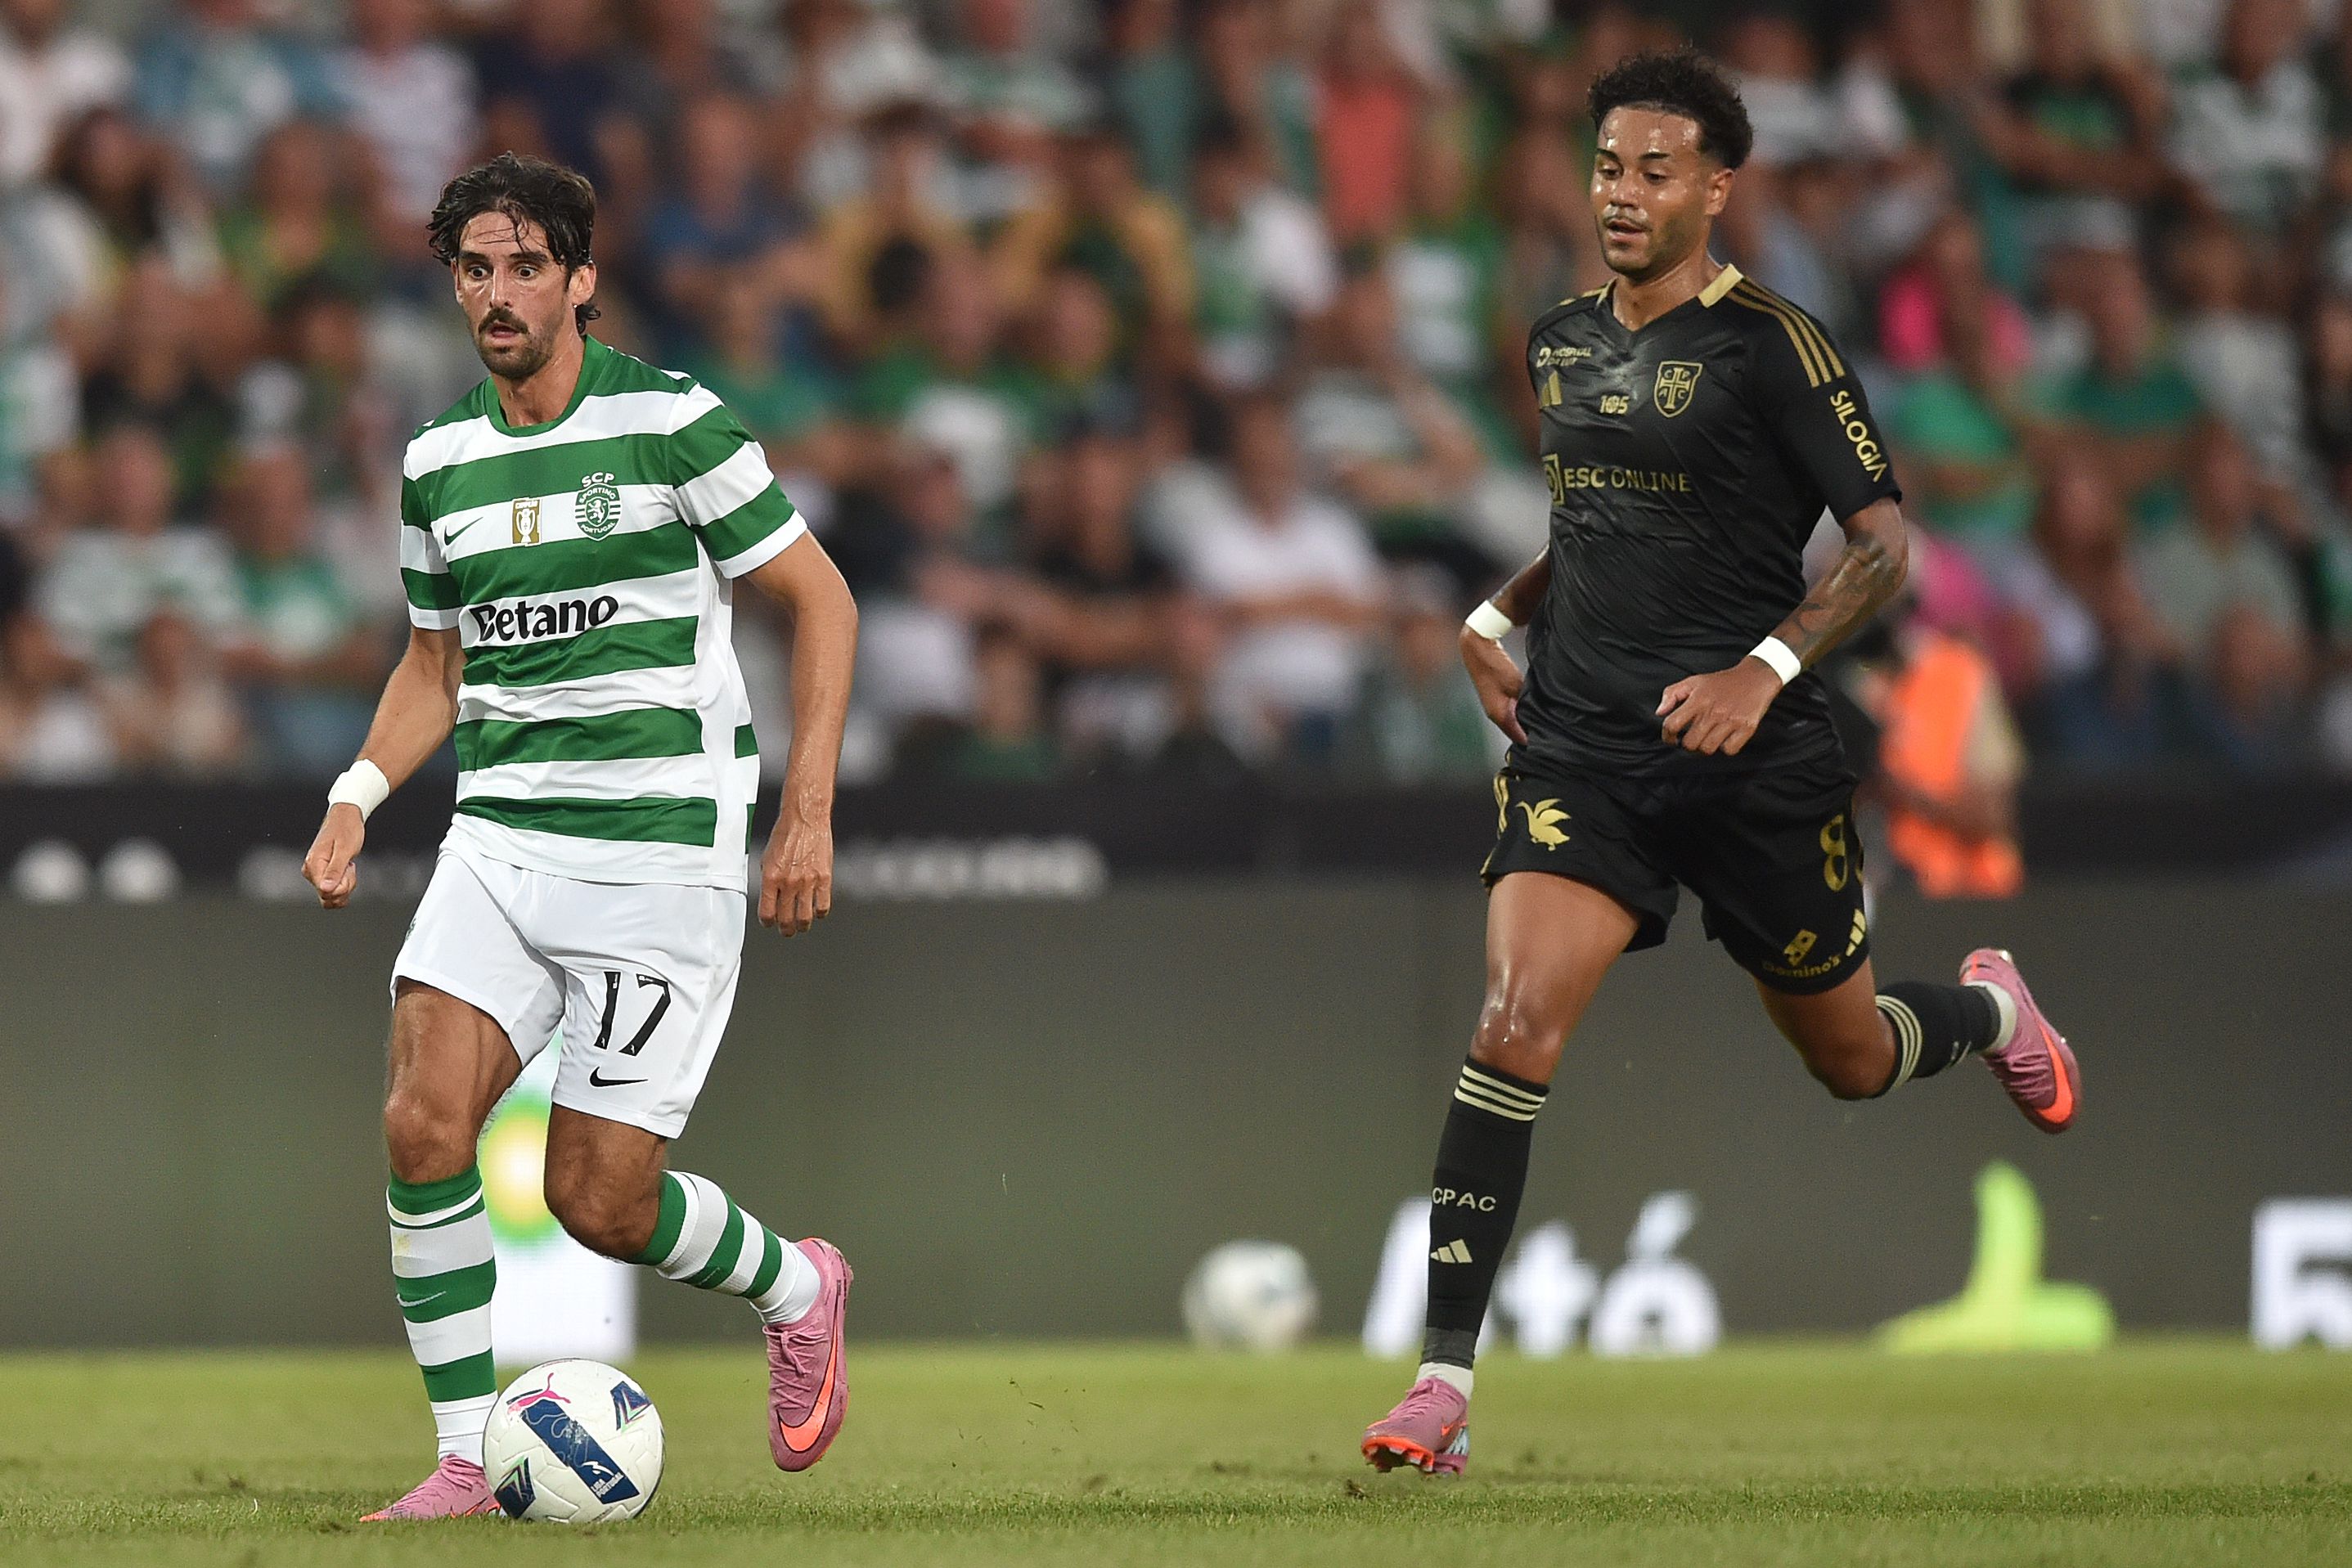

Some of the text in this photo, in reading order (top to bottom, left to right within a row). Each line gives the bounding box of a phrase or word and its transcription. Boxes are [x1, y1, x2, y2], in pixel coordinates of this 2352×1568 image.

[581, 472, 615, 488] SCP
[1563, 467, 1692, 492] ESC ONLINE
[469, 595, 619, 642] Betano
[1819, 814, 1848, 892] 8
[594, 971, 672, 1057] 17
